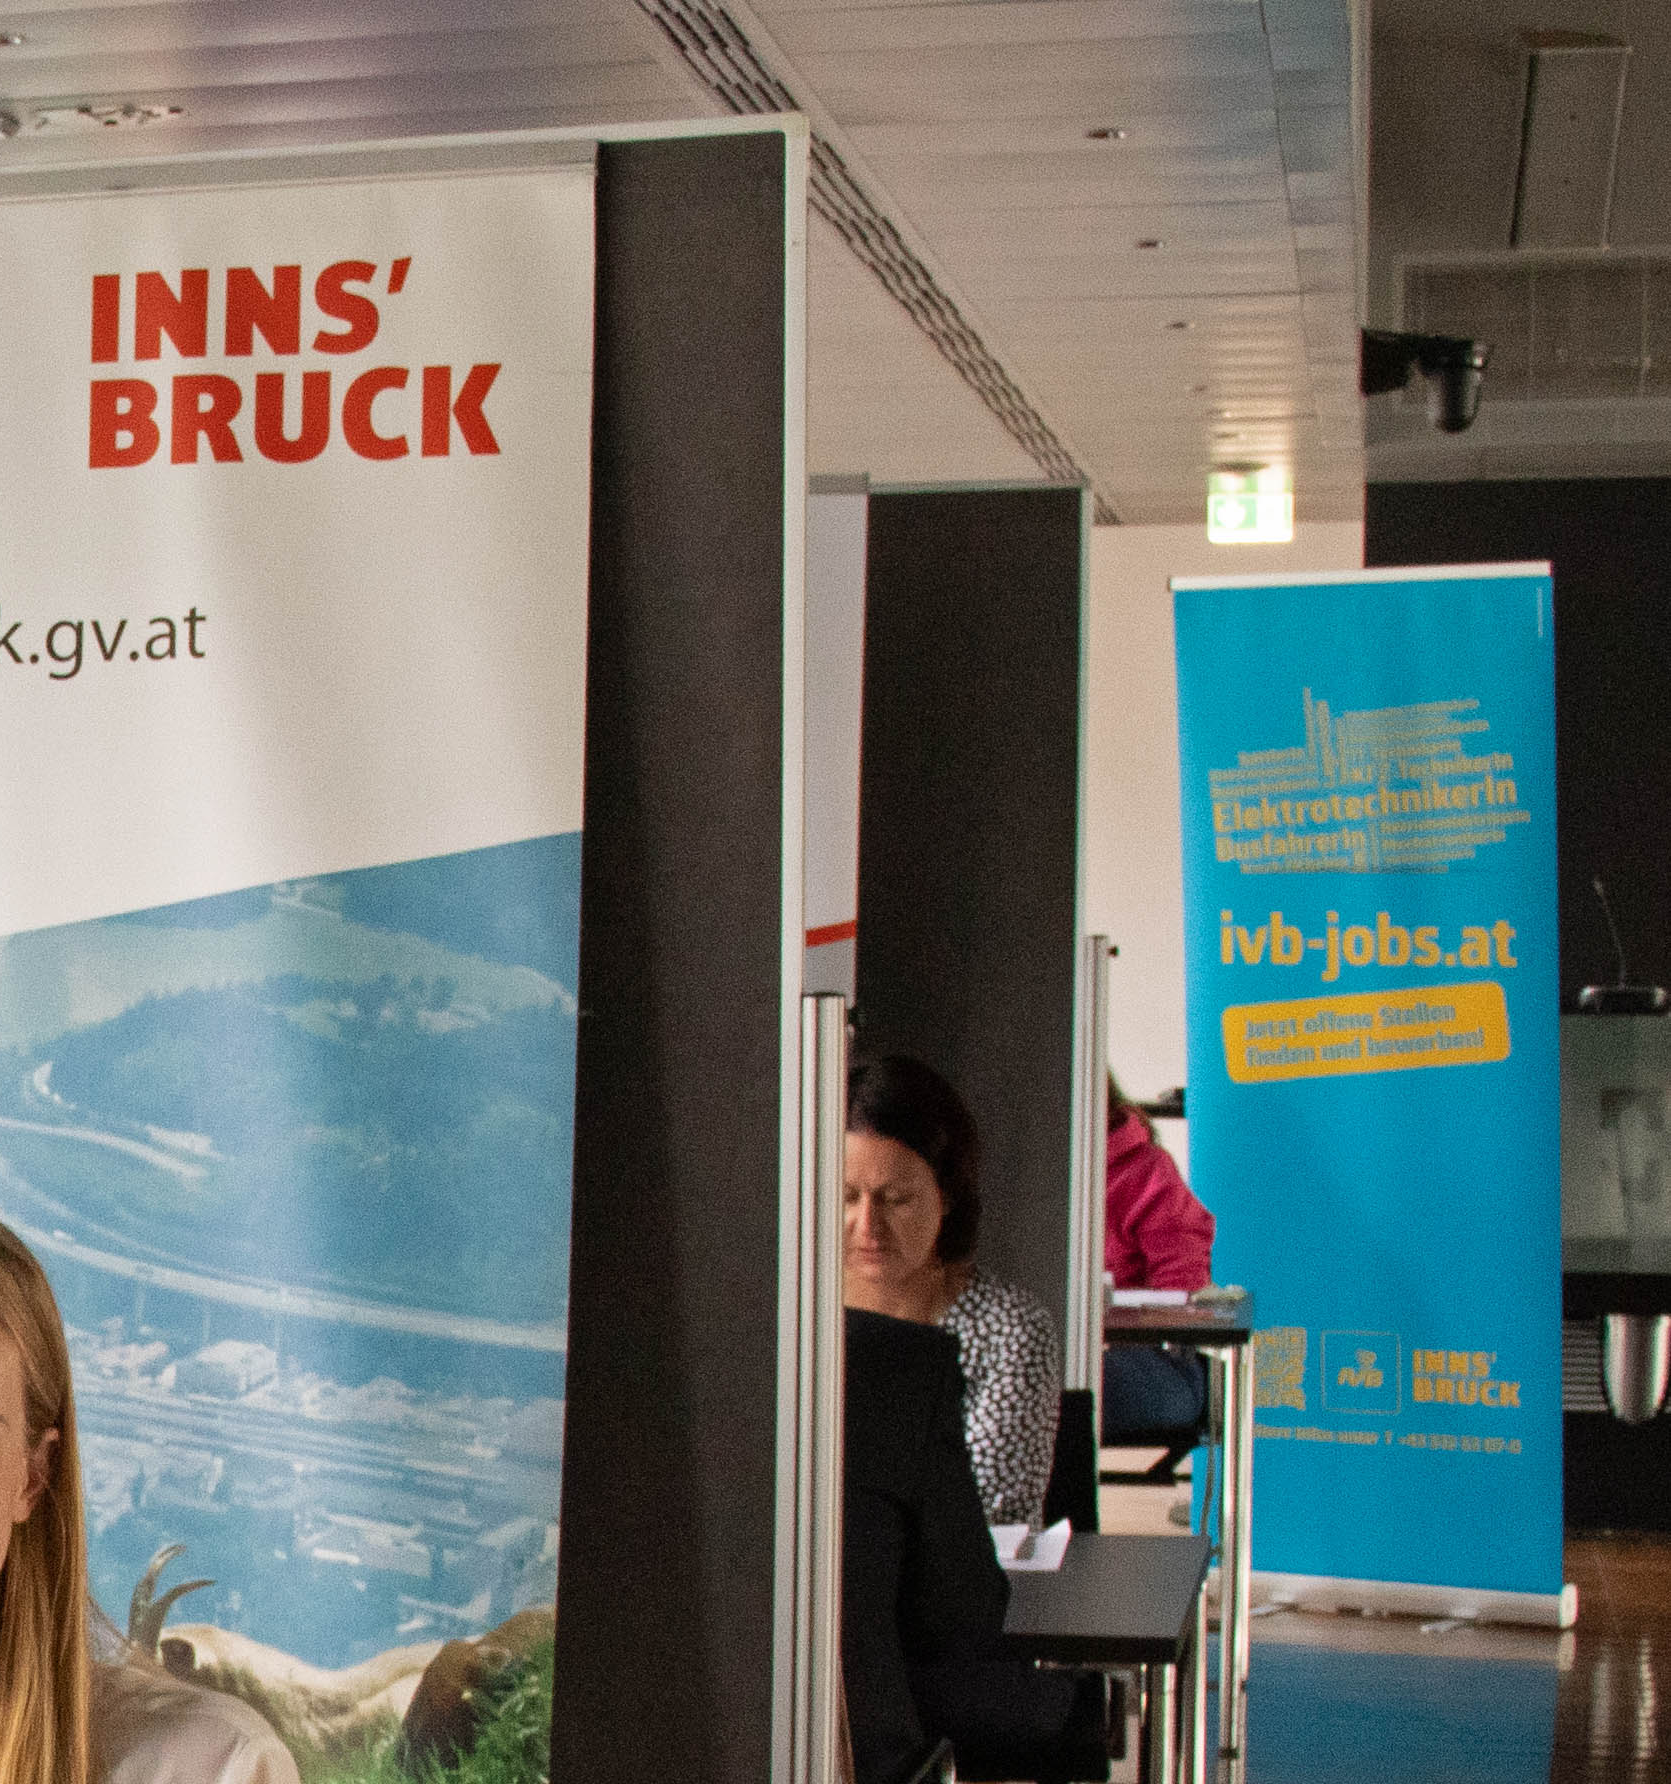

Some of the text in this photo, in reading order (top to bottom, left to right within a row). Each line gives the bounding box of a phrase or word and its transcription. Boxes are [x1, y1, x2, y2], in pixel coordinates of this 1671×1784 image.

[87, 362, 503, 470] BRUCK
[1220, 910, 1518, 982] ivb-jobs.at
[1412, 1376, 1522, 1408] BRUCK
